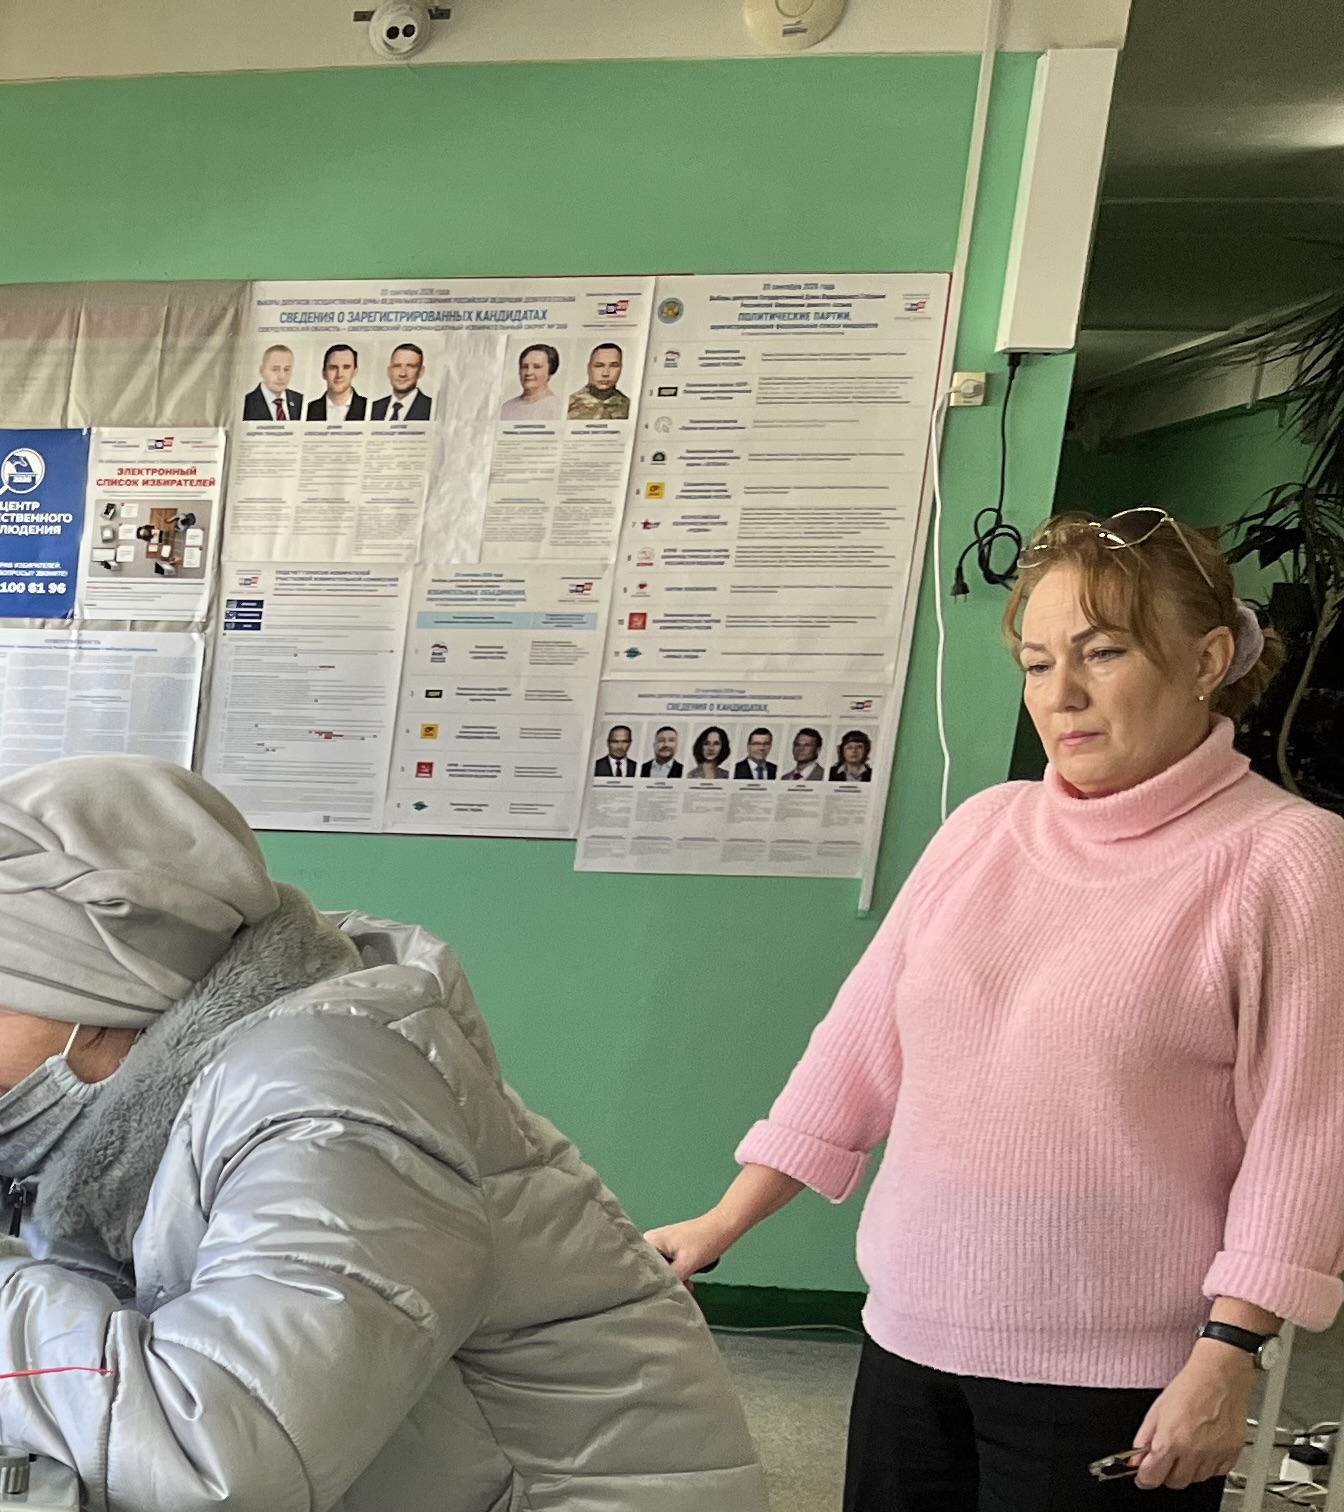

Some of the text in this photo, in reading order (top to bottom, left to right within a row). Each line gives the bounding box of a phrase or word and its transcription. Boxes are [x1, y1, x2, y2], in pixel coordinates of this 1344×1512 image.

[280, 309, 548, 323] СВЕДЕНИЯ О ЗАРЕГИСТРИРОВАННЫХ КАНДИДАТАХ
[738, 312, 811, 321] ПОЛИТИЧЕСКИЕ
[117, 466, 197, 475] ЭЛЕКТРОННЫЙ
[142, 477, 216, 486] ИЗБИРАТЕЛЕЙ
[0, 501, 40, 512] ЦЕНТР
[0, 582, 25, 593] 100
[28, 582, 46, 593] 61
[48, 582, 66, 594] 96
